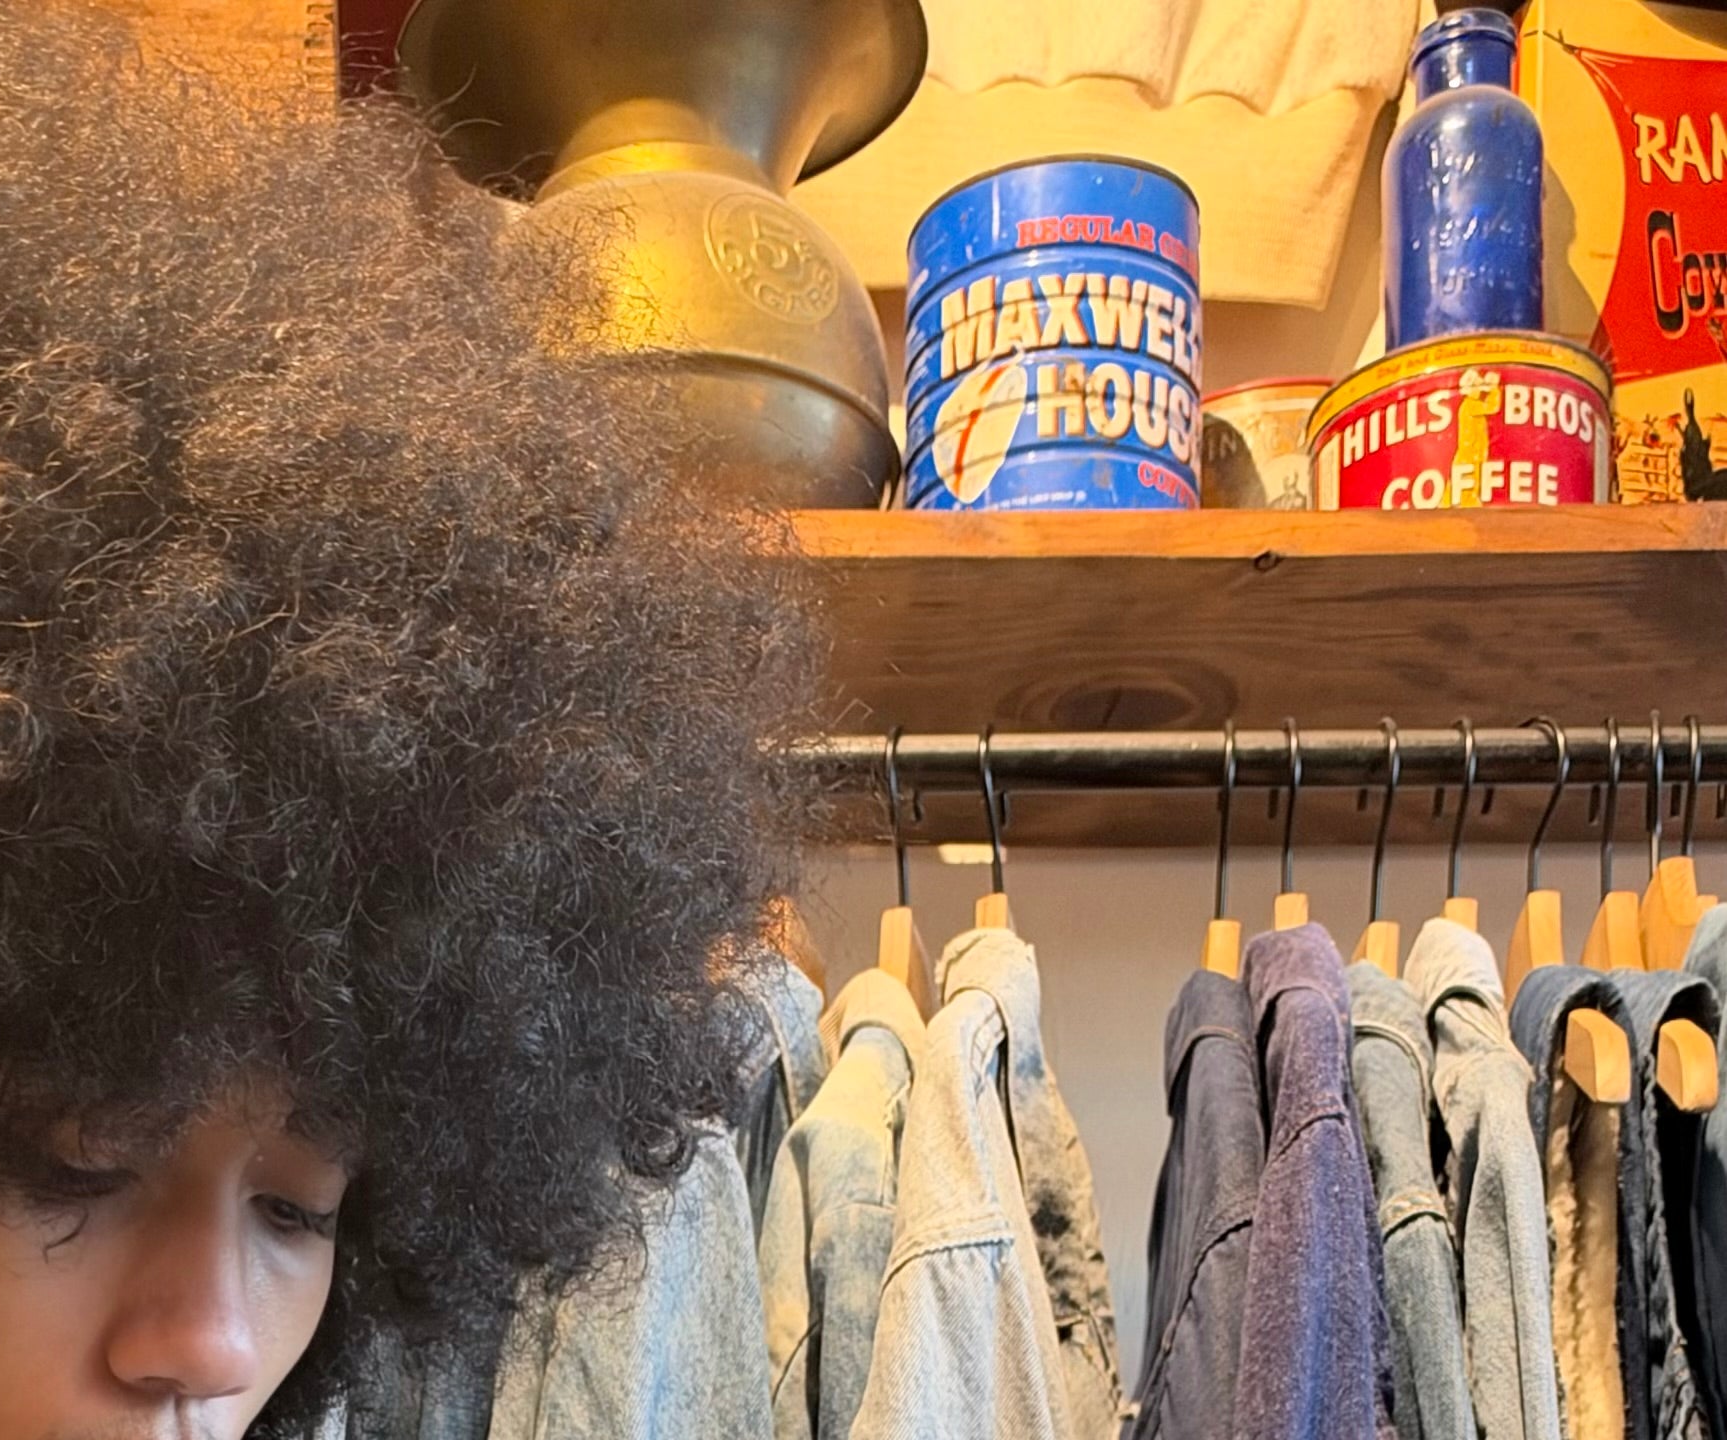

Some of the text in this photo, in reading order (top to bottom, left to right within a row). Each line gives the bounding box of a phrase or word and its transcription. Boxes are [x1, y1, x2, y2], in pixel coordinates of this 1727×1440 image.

[1016, 215, 1155, 252] REGULAR
[1036, 362, 1201, 466] HOUS
[1342, 383, 1594, 469] HILLS BROS
[1381, 460, 1559, 511] COFFEE
